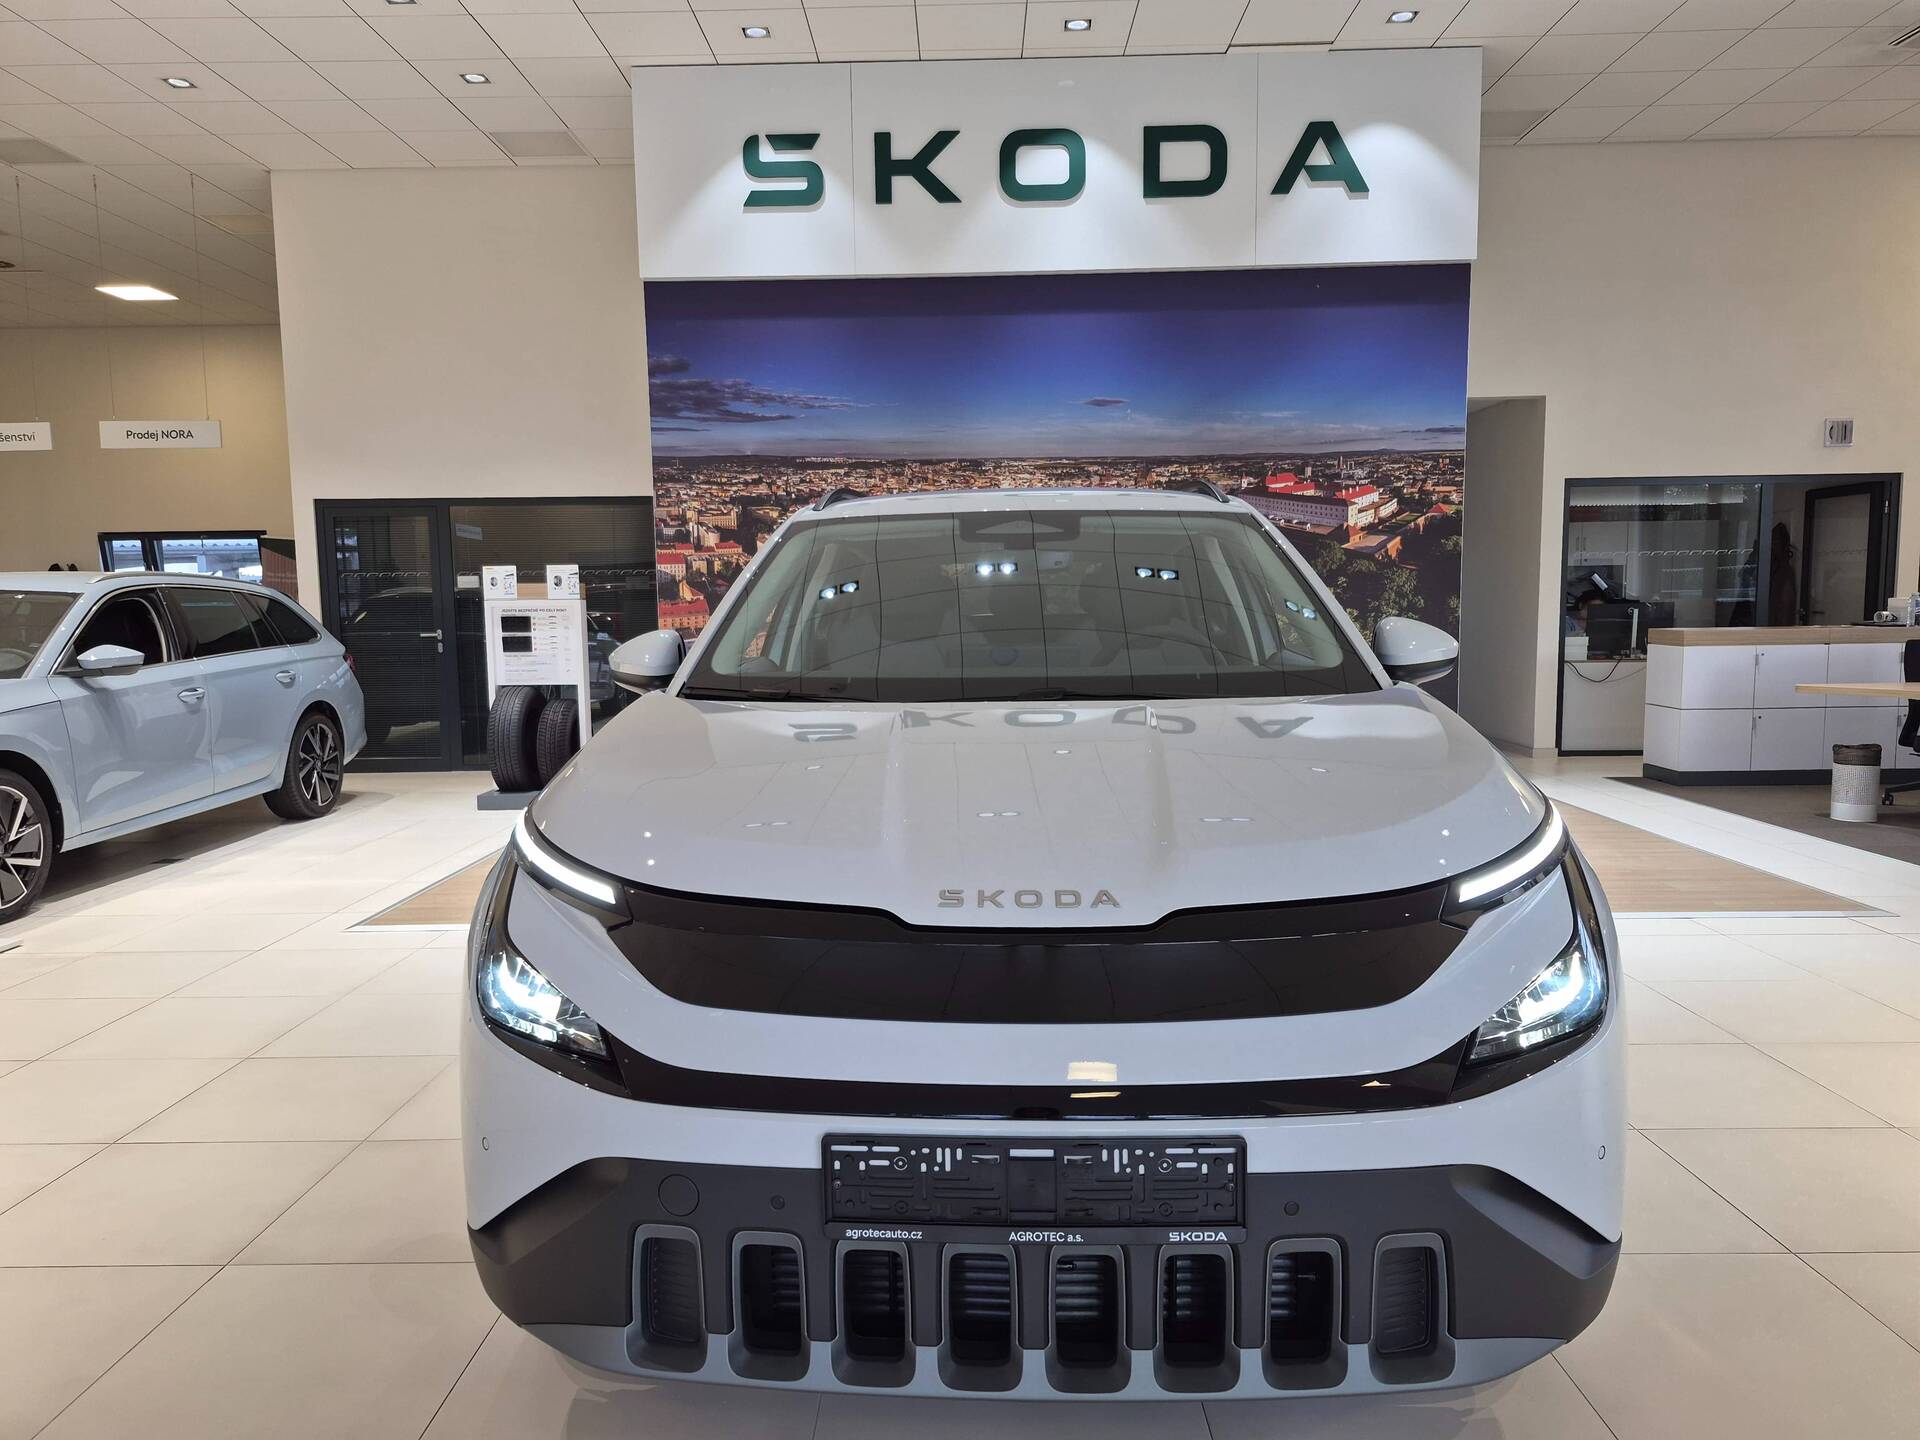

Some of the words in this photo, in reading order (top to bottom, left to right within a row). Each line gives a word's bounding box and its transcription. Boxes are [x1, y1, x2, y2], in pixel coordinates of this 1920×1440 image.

[126, 430, 159, 441] Prodej
[161, 430, 194, 440] NORA
[845, 1228, 923, 1239] agrotecauto.cz
[1009, 1231, 1065, 1242] AGROTEC
[1067, 1234, 1084, 1242] a.s.
